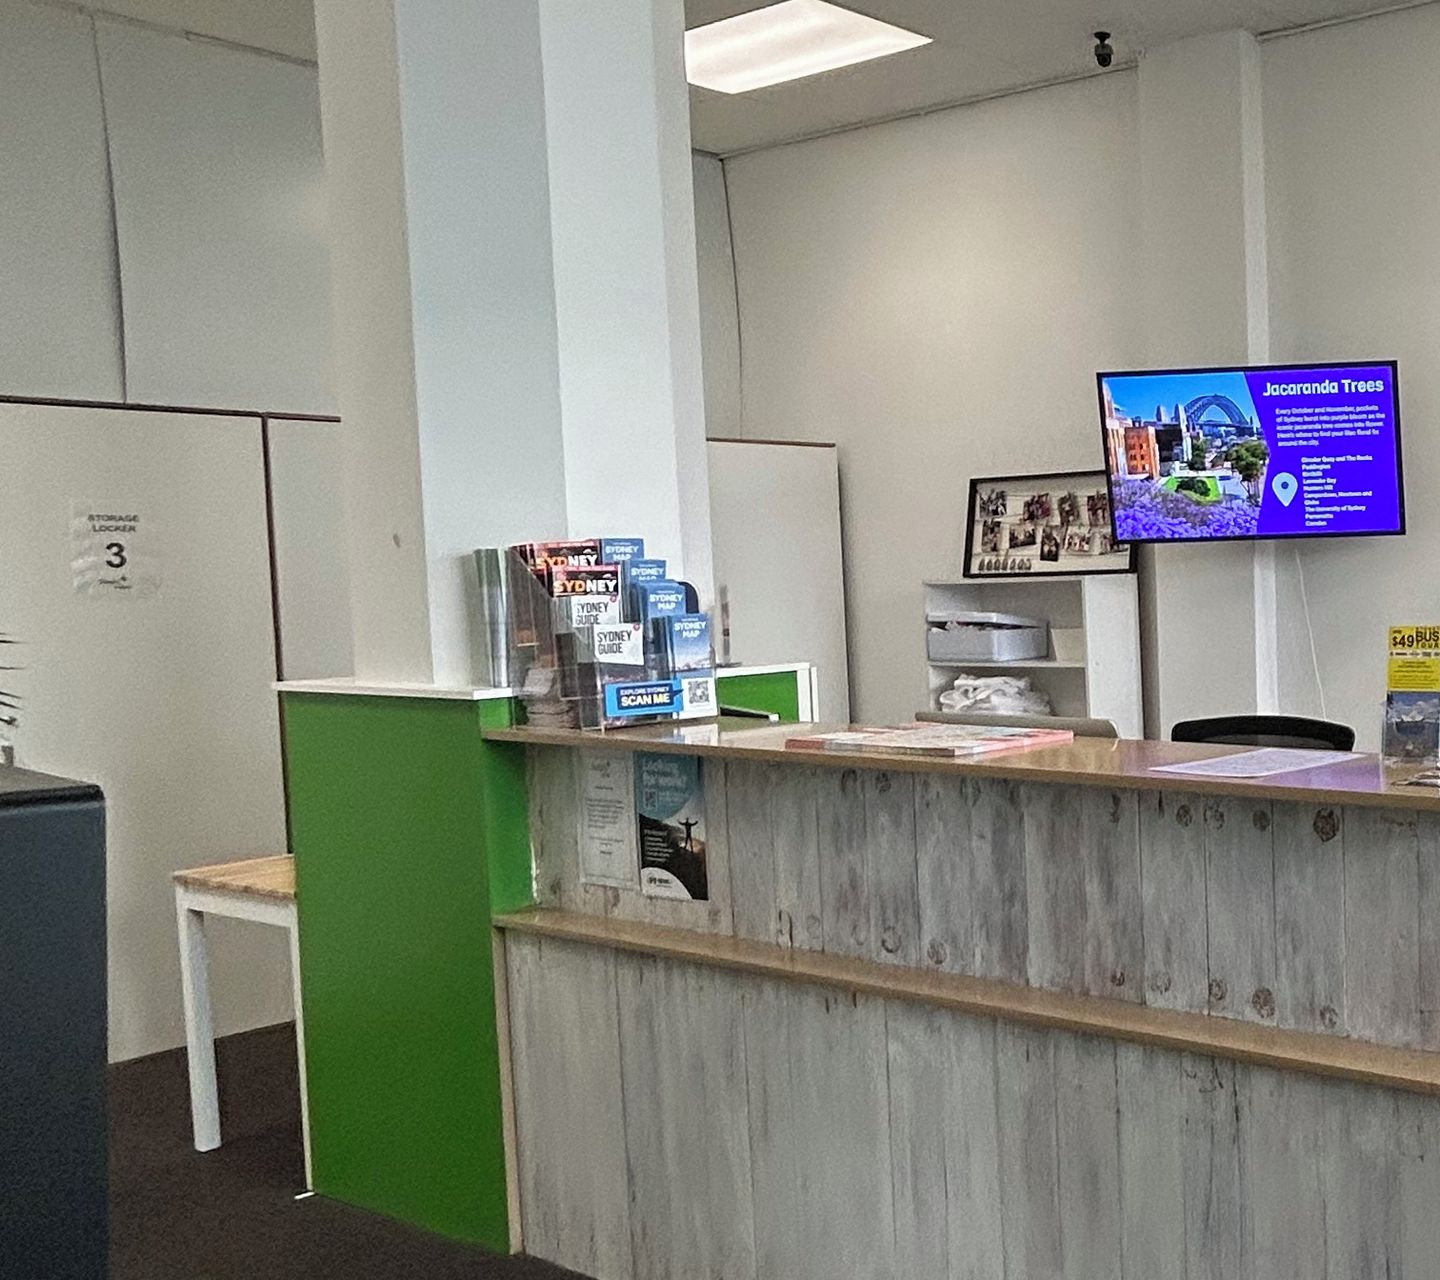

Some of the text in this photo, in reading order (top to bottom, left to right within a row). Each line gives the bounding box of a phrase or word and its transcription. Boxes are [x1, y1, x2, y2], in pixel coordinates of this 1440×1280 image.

[1263, 379, 1384, 396] Jacaranda Trees
[88, 514, 139, 522] STORAGE
[106, 542, 127, 568] 3
[605, 545, 640, 554] SYDNEY
[536, 555, 598, 568] SYDNEY
[631, 568, 665, 576] SYDNEY
[553, 579, 617, 593] SYDNEY
[650, 594, 683, 602] SYDNEY
[657, 602, 677, 610] MAP
[674, 621, 707, 632] SYDNEY
[597, 631, 632, 642] SYDNEY
[682, 629, 701, 639] MAP
[1416, 631, 1439, 642] BUS
[1392, 635, 1414, 647] $49
[598, 643, 623, 654] GUIDE
[621, 693, 671, 706] SCAN ME
